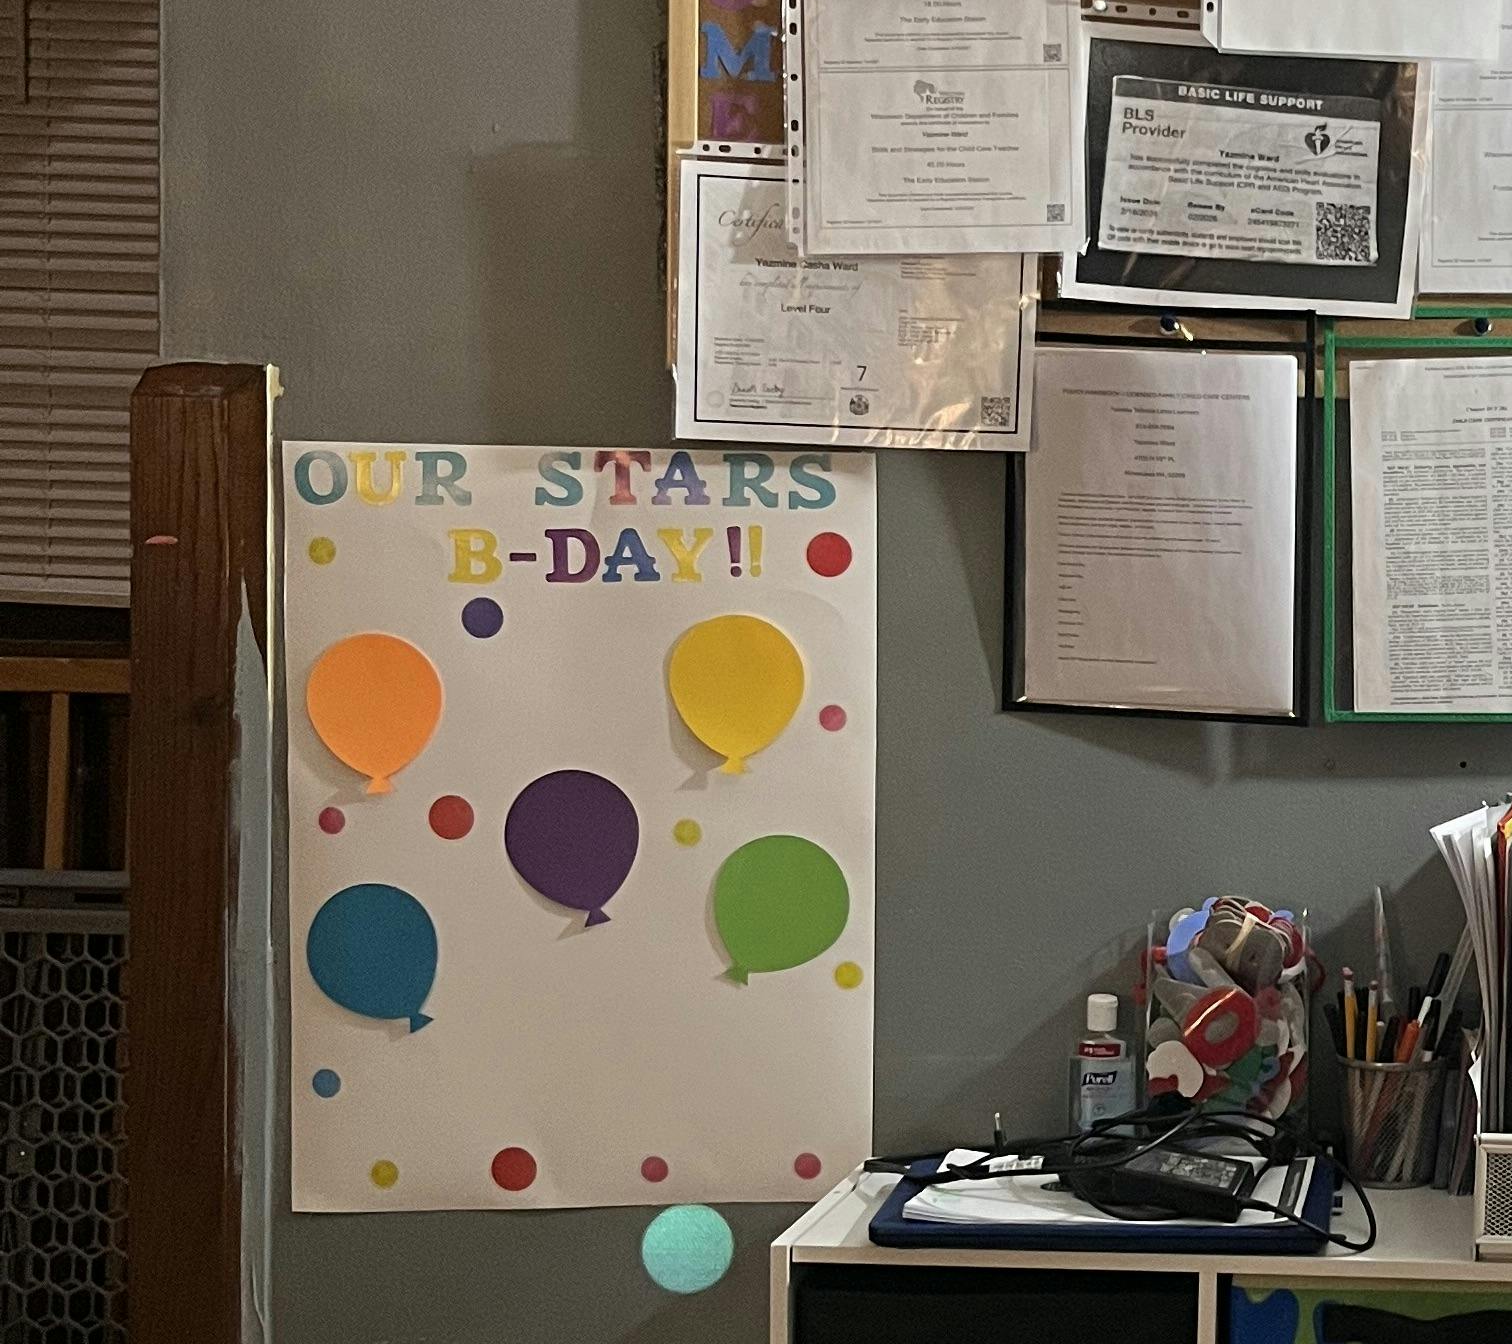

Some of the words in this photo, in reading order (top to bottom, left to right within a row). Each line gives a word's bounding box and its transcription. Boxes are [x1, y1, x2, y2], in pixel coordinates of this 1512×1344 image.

[1178, 86, 1221, 100] BASIC
[1225, 92, 1256, 104] LIFE
[1260, 94, 1325, 110] SUPPORT
[1123, 108, 1155, 121] BLS
[1122, 122, 1186, 139] Provider
[832, 261, 858, 271] Ward
[780, 304, 807, 313] Level
[809, 305, 831, 313] Four
[294, 450, 471, 506] OUR
[534, 450, 837, 509] STARS
[448, 524, 763, 584] B-DAY!!
